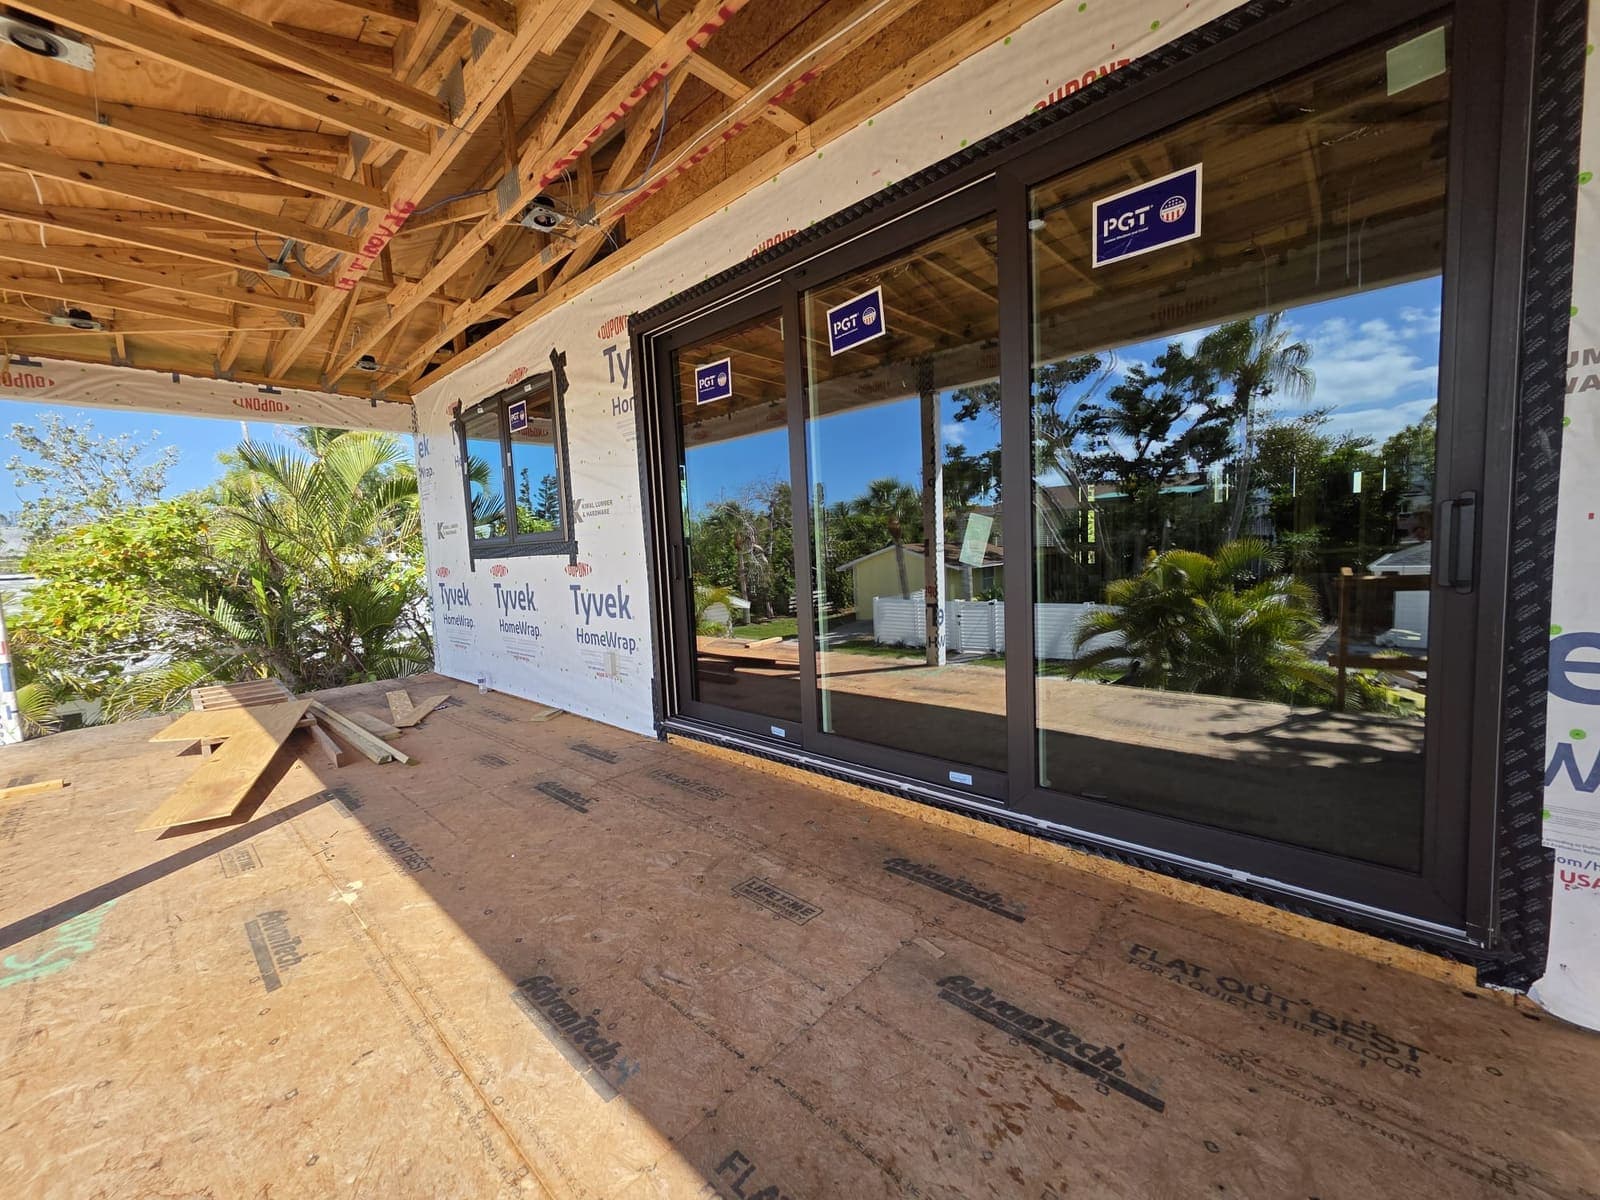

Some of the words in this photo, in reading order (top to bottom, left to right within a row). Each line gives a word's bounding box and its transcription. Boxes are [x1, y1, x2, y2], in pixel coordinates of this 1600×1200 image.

[1103, 205, 1150, 238] PGT
[834, 313, 858, 336] PGT
[699, 375, 716, 389] PGT
[240, 397, 283, 413] DUPONT
[438, 582, 471, 611] Tyvek
[493, 582, 537, 617] Tyvek
[569, 584, 632, 626] Tyvek
[443, 614, 474, 630] HomeWrap
[499, 618, 540, 640] HomeWrap
[576, 627, 637, 655] HomeWrap
[744, 880, 817, 917] LIFETIME
[1128, 943, 1211, 979] FLAT
[1216, 976, 1301, 1013] OUT
[1310, 1008, 1431, 1063] BEST
[935, 975, 1123, 1073] AdvanTech
[1128, 958, 1165, 977] FOR
[1188, 981, 1254, 1010] QUIET
[1265, 1010, 1329, 1038] STIFF
[1333, 1035, 1424, 1080] FLOOR
